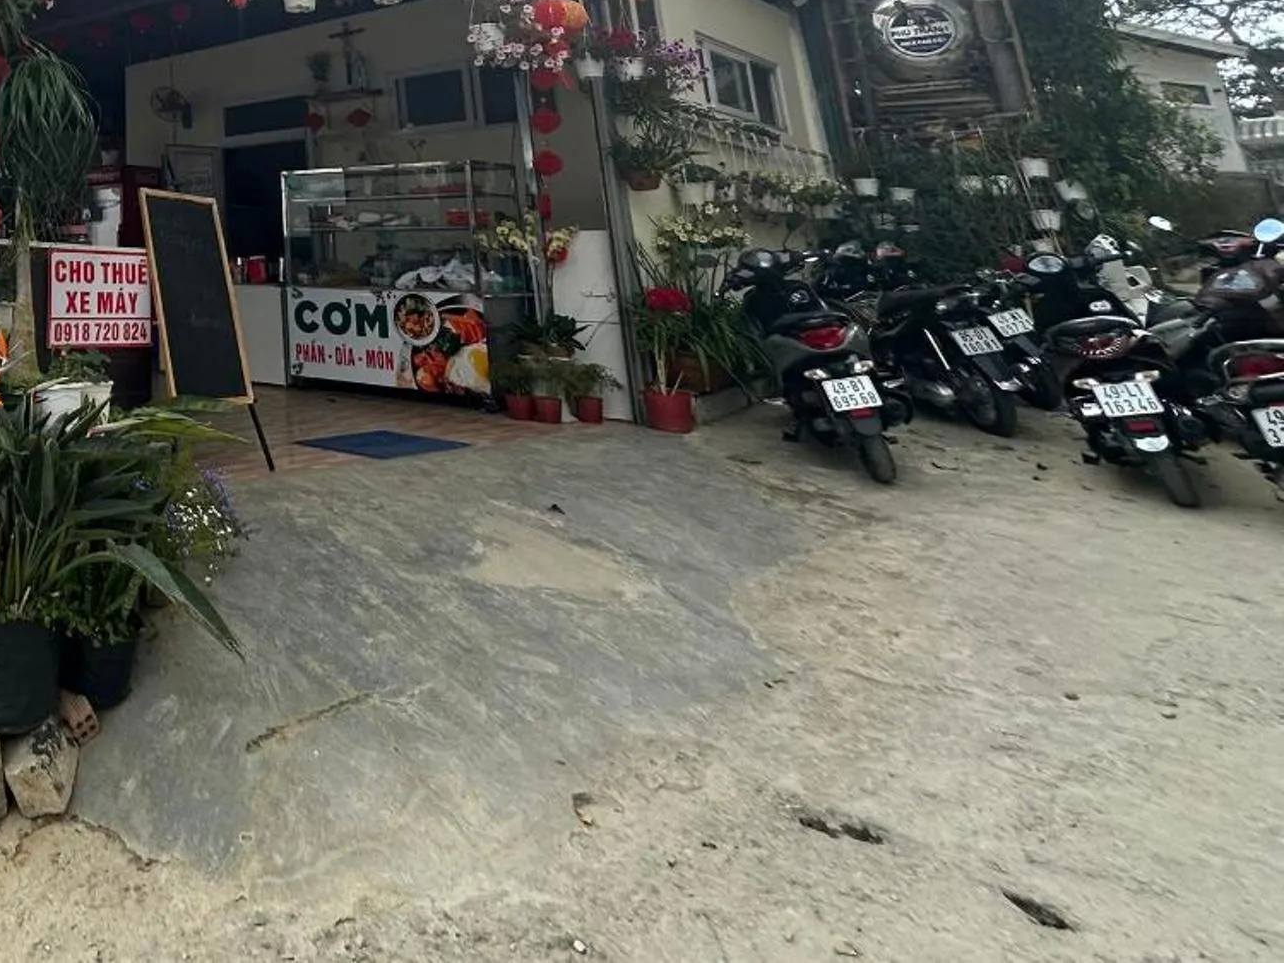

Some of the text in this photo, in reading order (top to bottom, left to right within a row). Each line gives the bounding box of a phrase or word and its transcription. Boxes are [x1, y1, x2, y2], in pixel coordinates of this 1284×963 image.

[54, 257, 148, 286] CHO THUÊ
[65, 286, 139, 315] XE MÁY
[53, 321, 149, 343] 0918 720 824
[293, 297, 390, 339] CƠM
